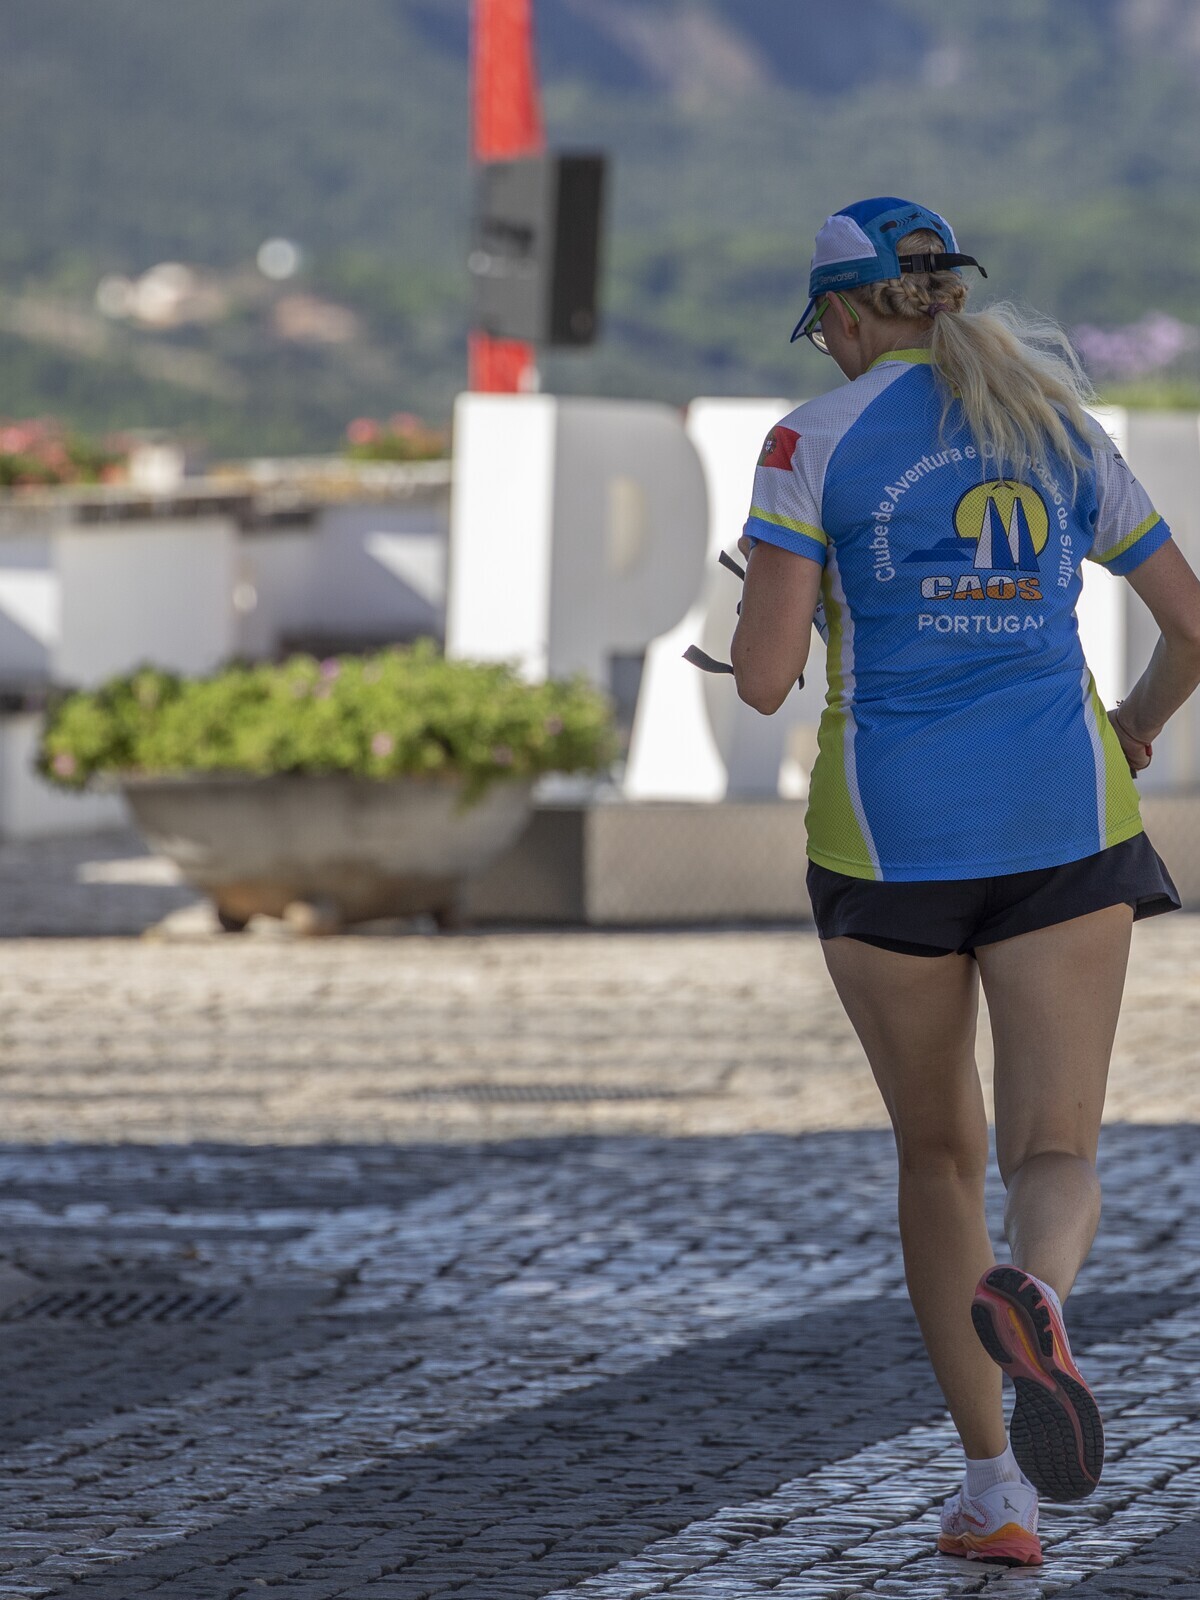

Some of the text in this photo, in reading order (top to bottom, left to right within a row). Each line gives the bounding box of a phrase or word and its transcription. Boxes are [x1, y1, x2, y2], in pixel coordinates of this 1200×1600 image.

[964, 445, 977, 460] e
[884, 447, 963, 503] Aventura
[871, 501, 895, 523] de
[1057, 507, 1068, 530] de
[869, 525, 896, 582] Clube
[1057, 534, 1075, 588] Sintra
[920, 575, 1043, 600] CAOS
